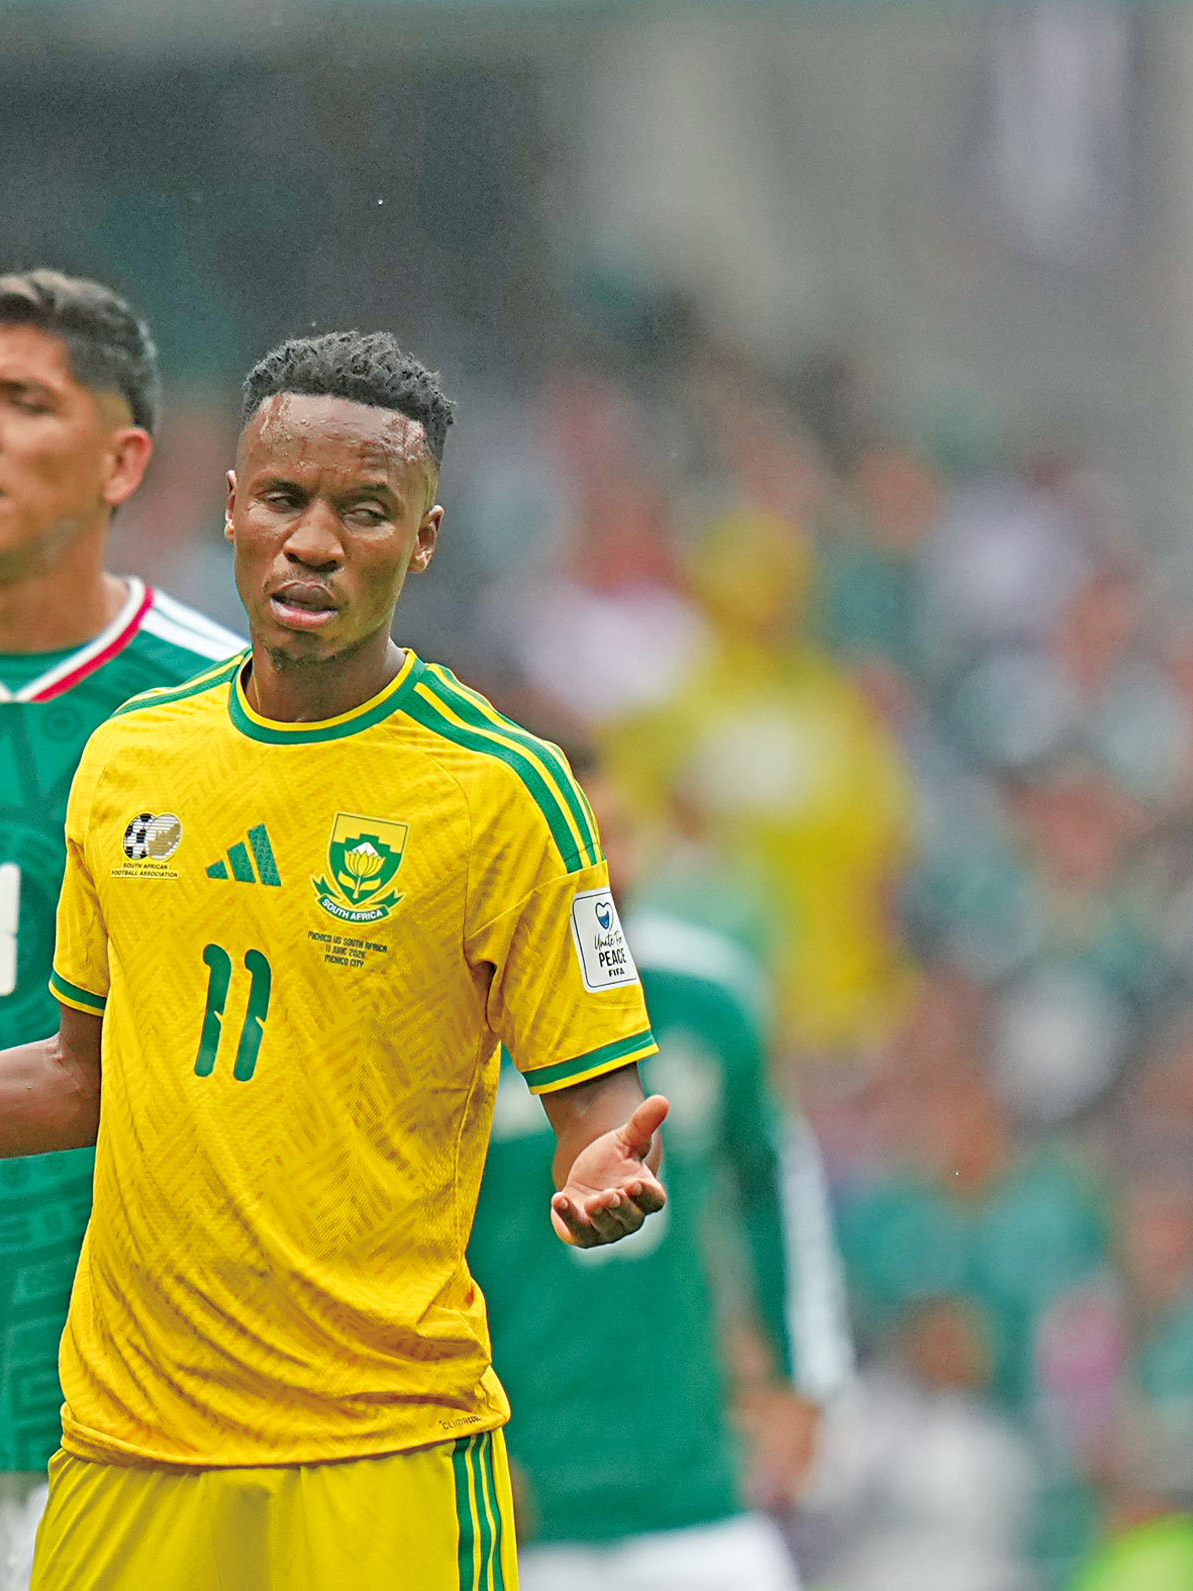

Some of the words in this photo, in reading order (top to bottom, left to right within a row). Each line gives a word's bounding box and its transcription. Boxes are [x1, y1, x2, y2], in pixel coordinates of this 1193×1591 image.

[322, 898, 349, 919] SOUTH
[350, 909, 383, 921] AFRICA
[307, 931, 332, 943] MEXICO
[343, 937, 364, 949] SOUTH
[594, 933, 614, 951] Unite
[332, 946, 347, 956] JUNE
[598, 947, 627, 968] PEACE
[324, 954, 349, 966] MEXICO
[350, 959, 365, 968] CITY
[608, 967, 625, 977] FIFA
[193, 943, 272, 1082] 11
